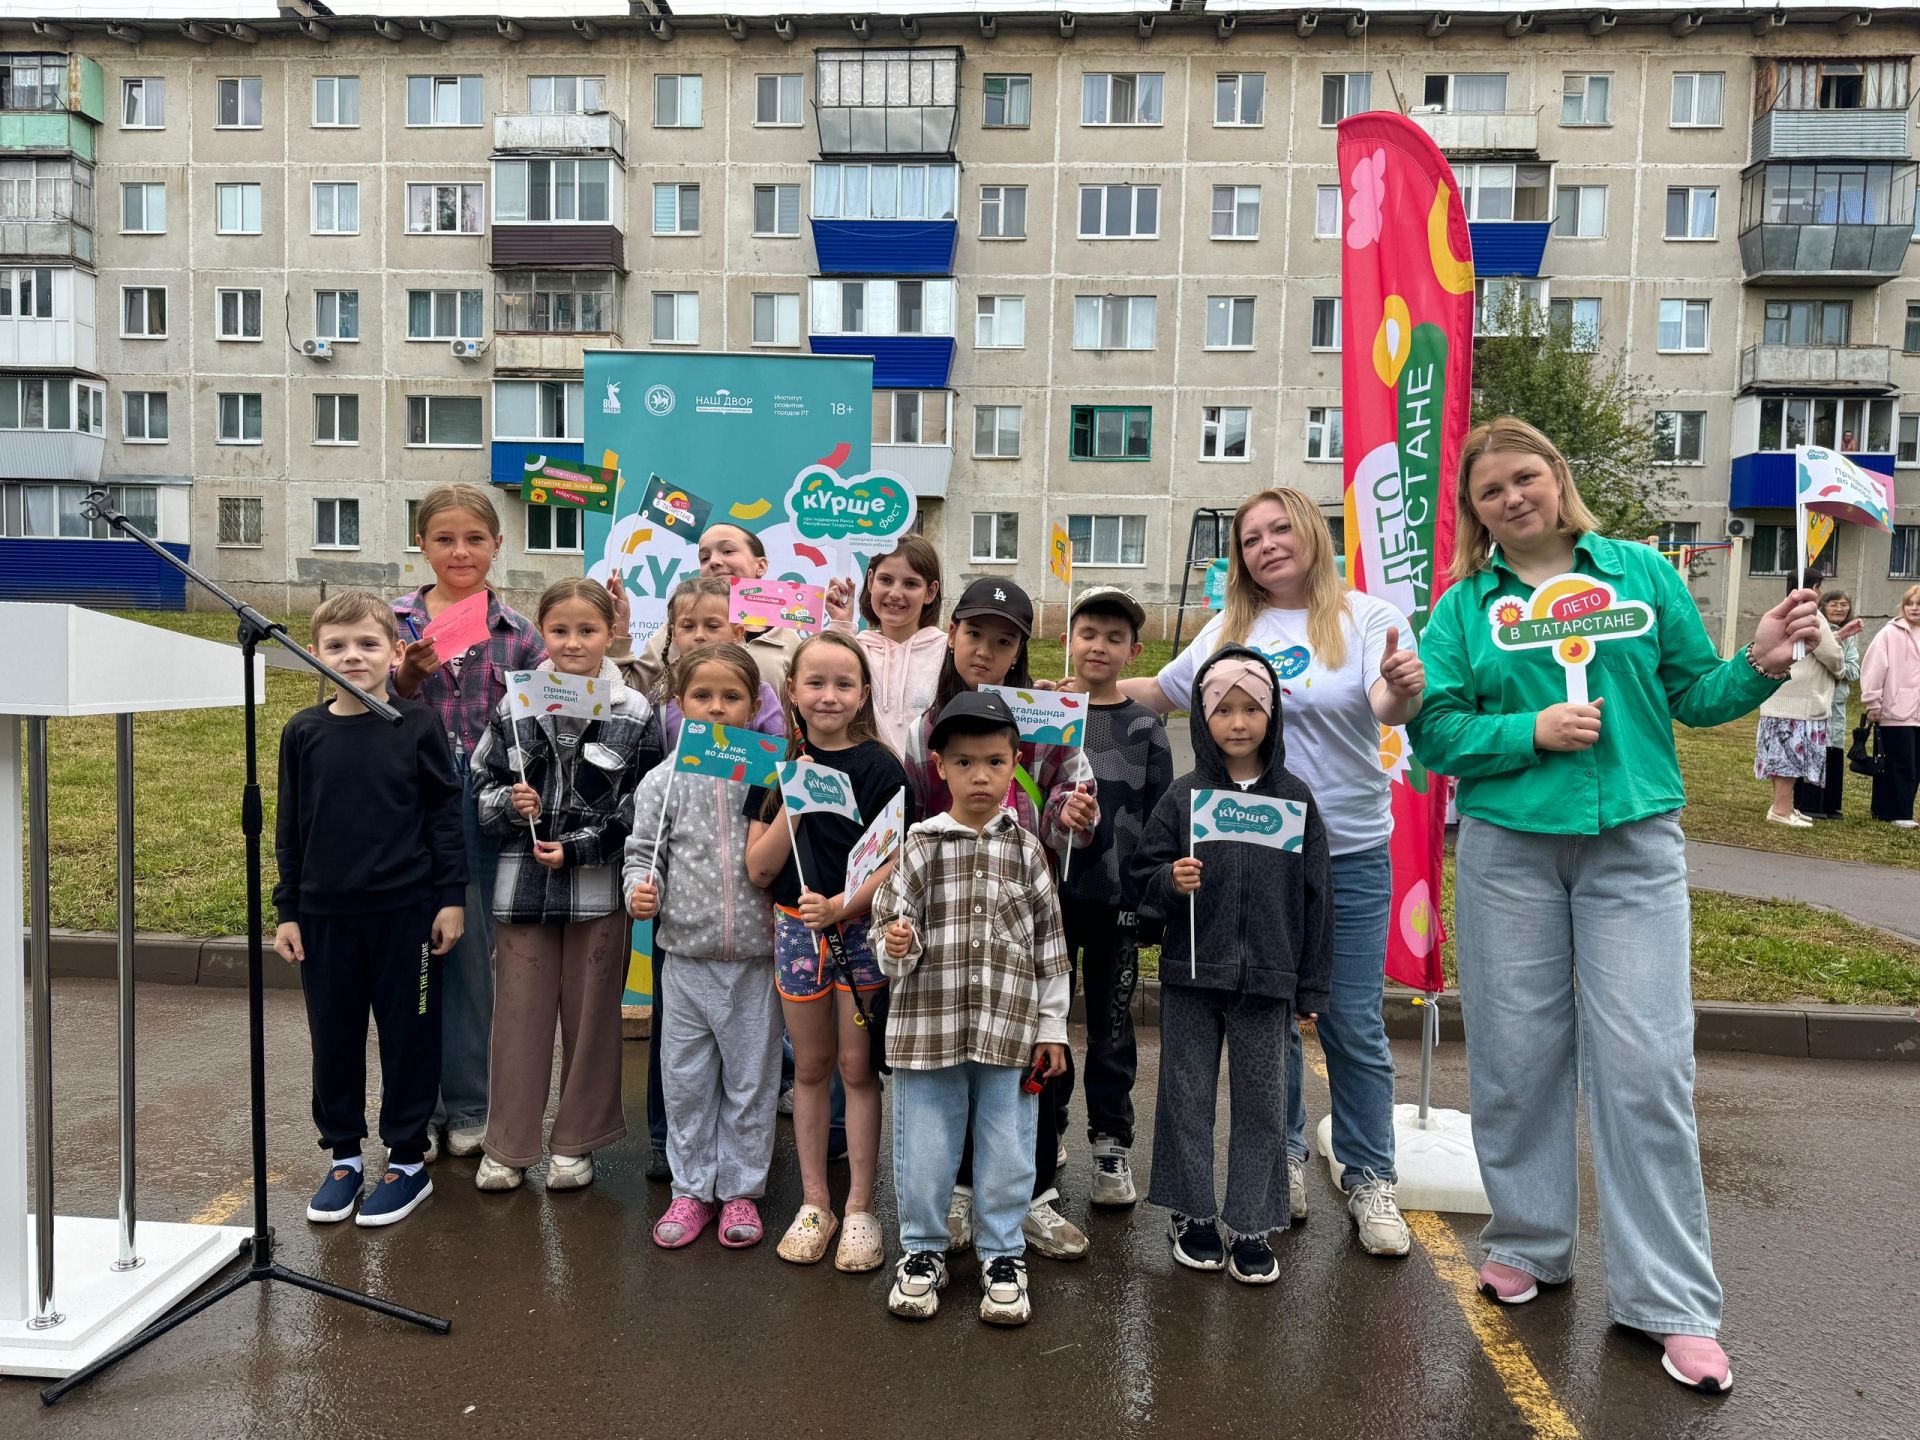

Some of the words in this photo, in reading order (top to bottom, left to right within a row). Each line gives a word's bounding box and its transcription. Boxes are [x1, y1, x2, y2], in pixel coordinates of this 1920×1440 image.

[696, 396, 720, 405] НАШ
[724, 396, 752, 406] ДВОР
[830, 402, 854, 415] 18+
[879, 502, 902, 529] фест
[1373, 472, 1414, 584] ЛЕТО
[993, 588, 1006, 602] LA
[1562, 593, 1601, 617] ЛЕТО
[1510, 628, 1520, 640] В
[1531, 613, 1635, 637] ТАТАРСТАНЕ
[544, 686, 578, 696] Привет,
[544, 694, 578, 703] соседи!
[1009, 706, 1065, 718] егалдында
[730, 746, 746, 754] нас
[717, 752, 752, 764] дворе...
[420, 941, 428, 973] FUTURE
[829, 934, 846, 965] CWR
[420, 973, 428, 990] THE
[418, 990, 427, 1014] MAKE
